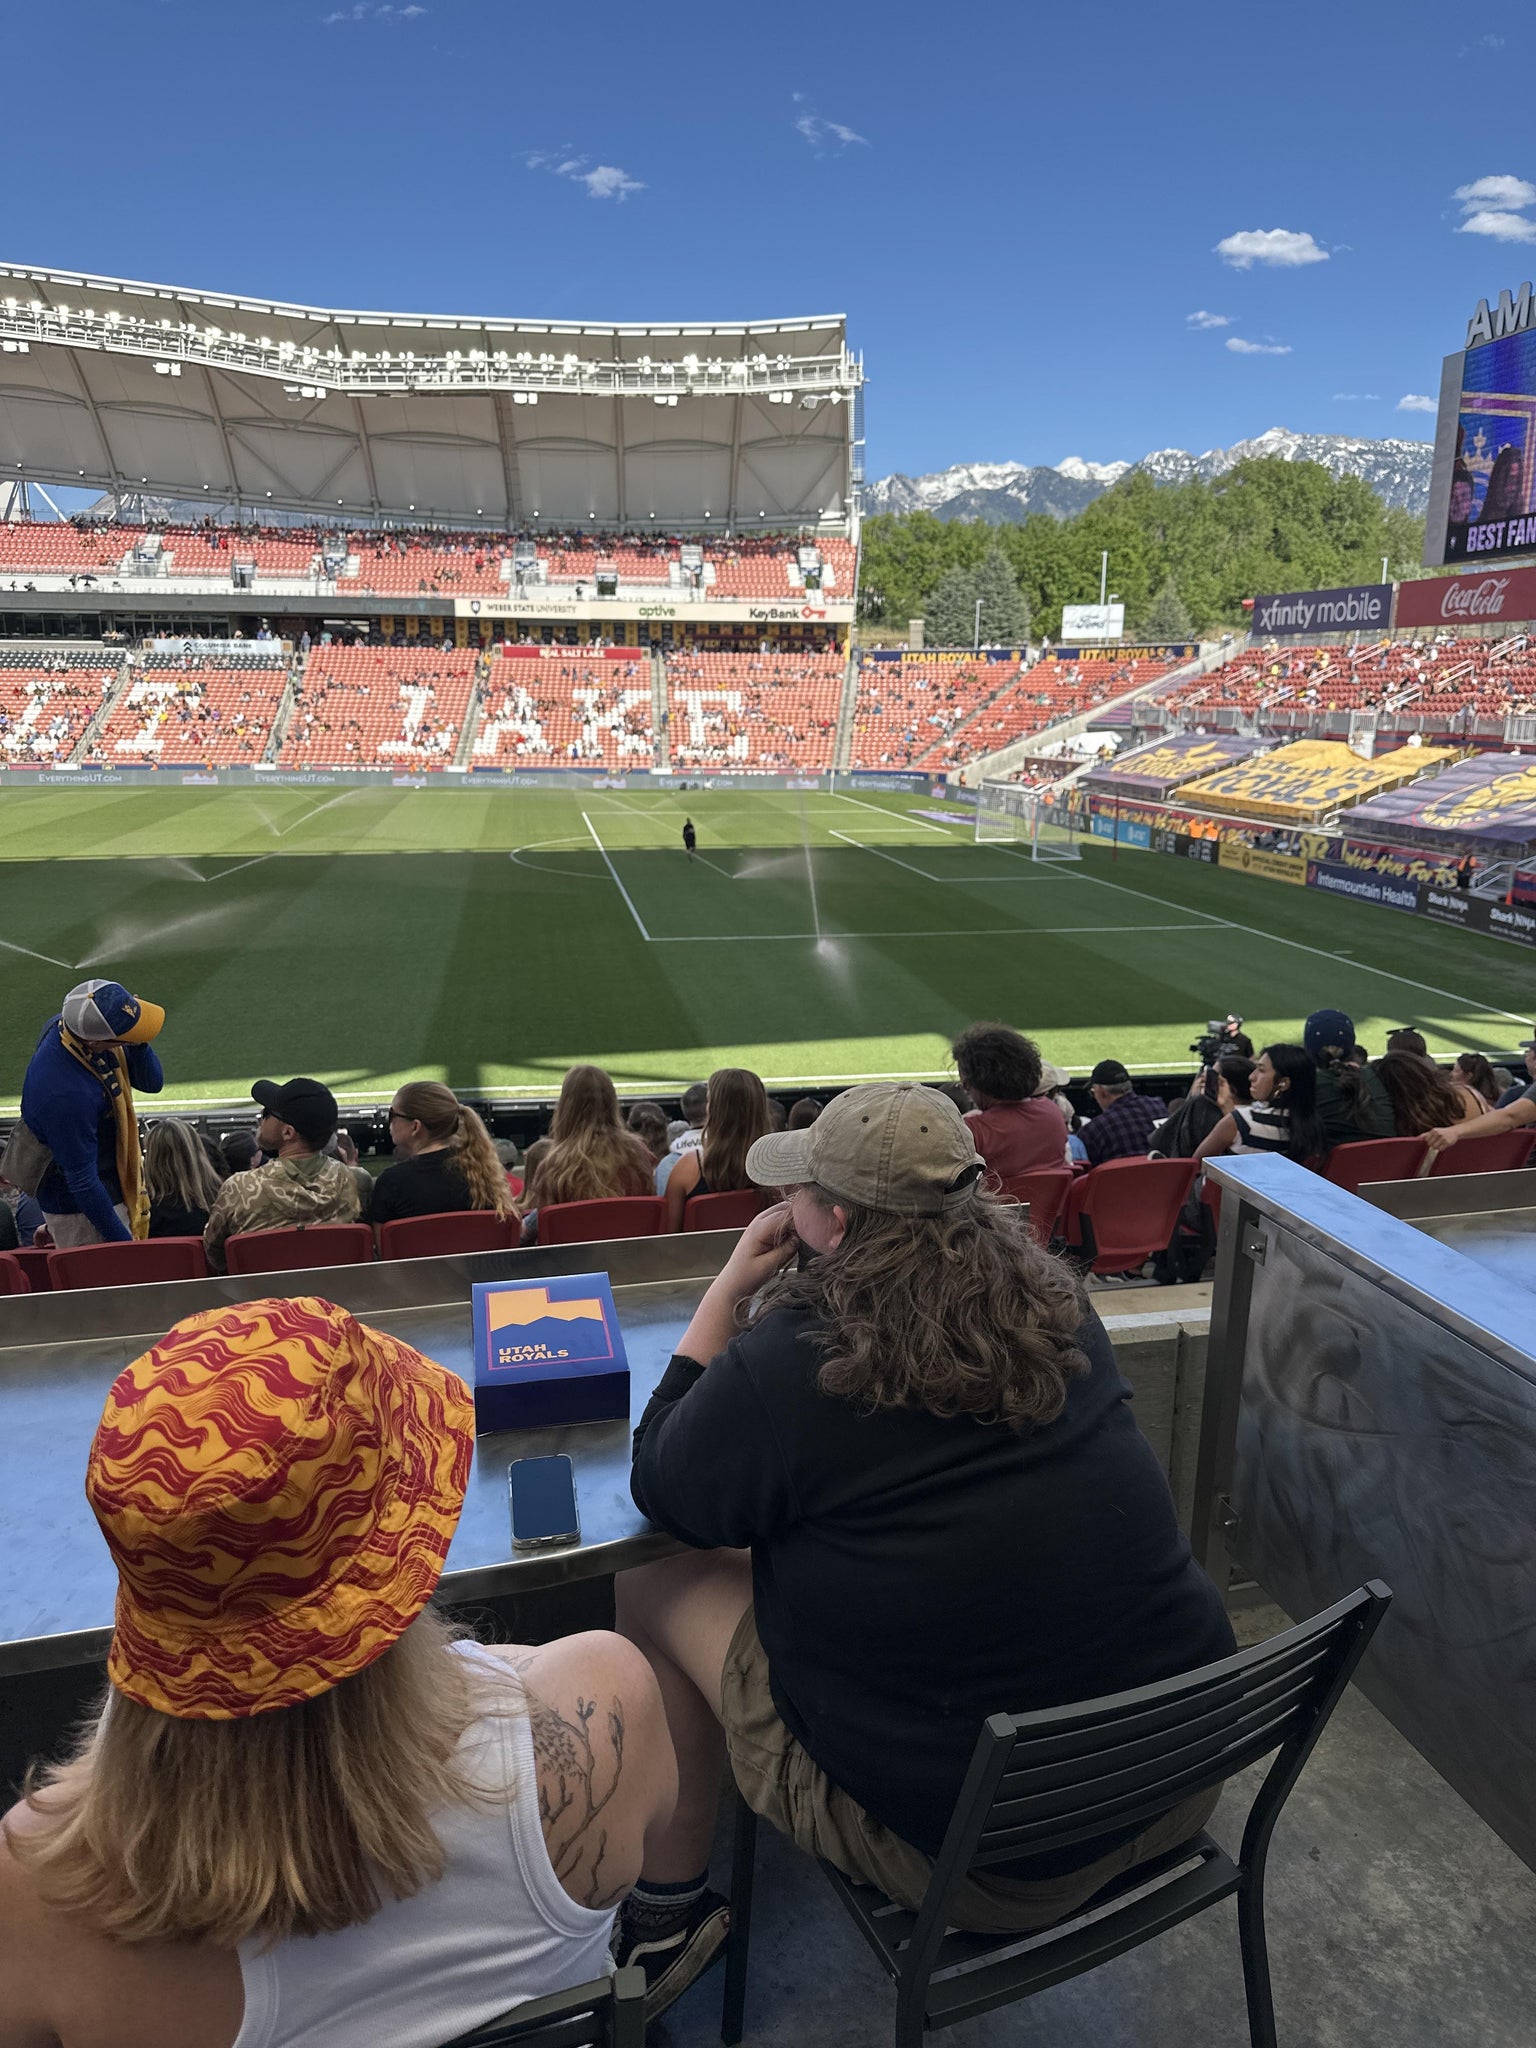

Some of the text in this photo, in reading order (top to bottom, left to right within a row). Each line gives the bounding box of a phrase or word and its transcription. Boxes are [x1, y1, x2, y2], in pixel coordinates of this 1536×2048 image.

[1465, 281, 1536, 349] AM
[1466, 522, 1506, 552] BEST
[486, 603, 577, 614] WEBER STATE UNIVERSITY
[638, 605, 676, 620] aptive
[750, 608, 799, 621] KeyBank
[1260, 592, 1381, 631] xfinity mobile
[561, 649, 582, 658] SALT
[583, 649, 606, 658] LAKE
[901, 651, 987, 664] UTAH ROYALS
[1079, 647, 1166, 660] UTAH ROYALS
[1317, 871, 1417, 908] Intermountain Health
[499, 1344, 547, 1356] UTAH
[499, 1349, 569, 1364] ROYALS
